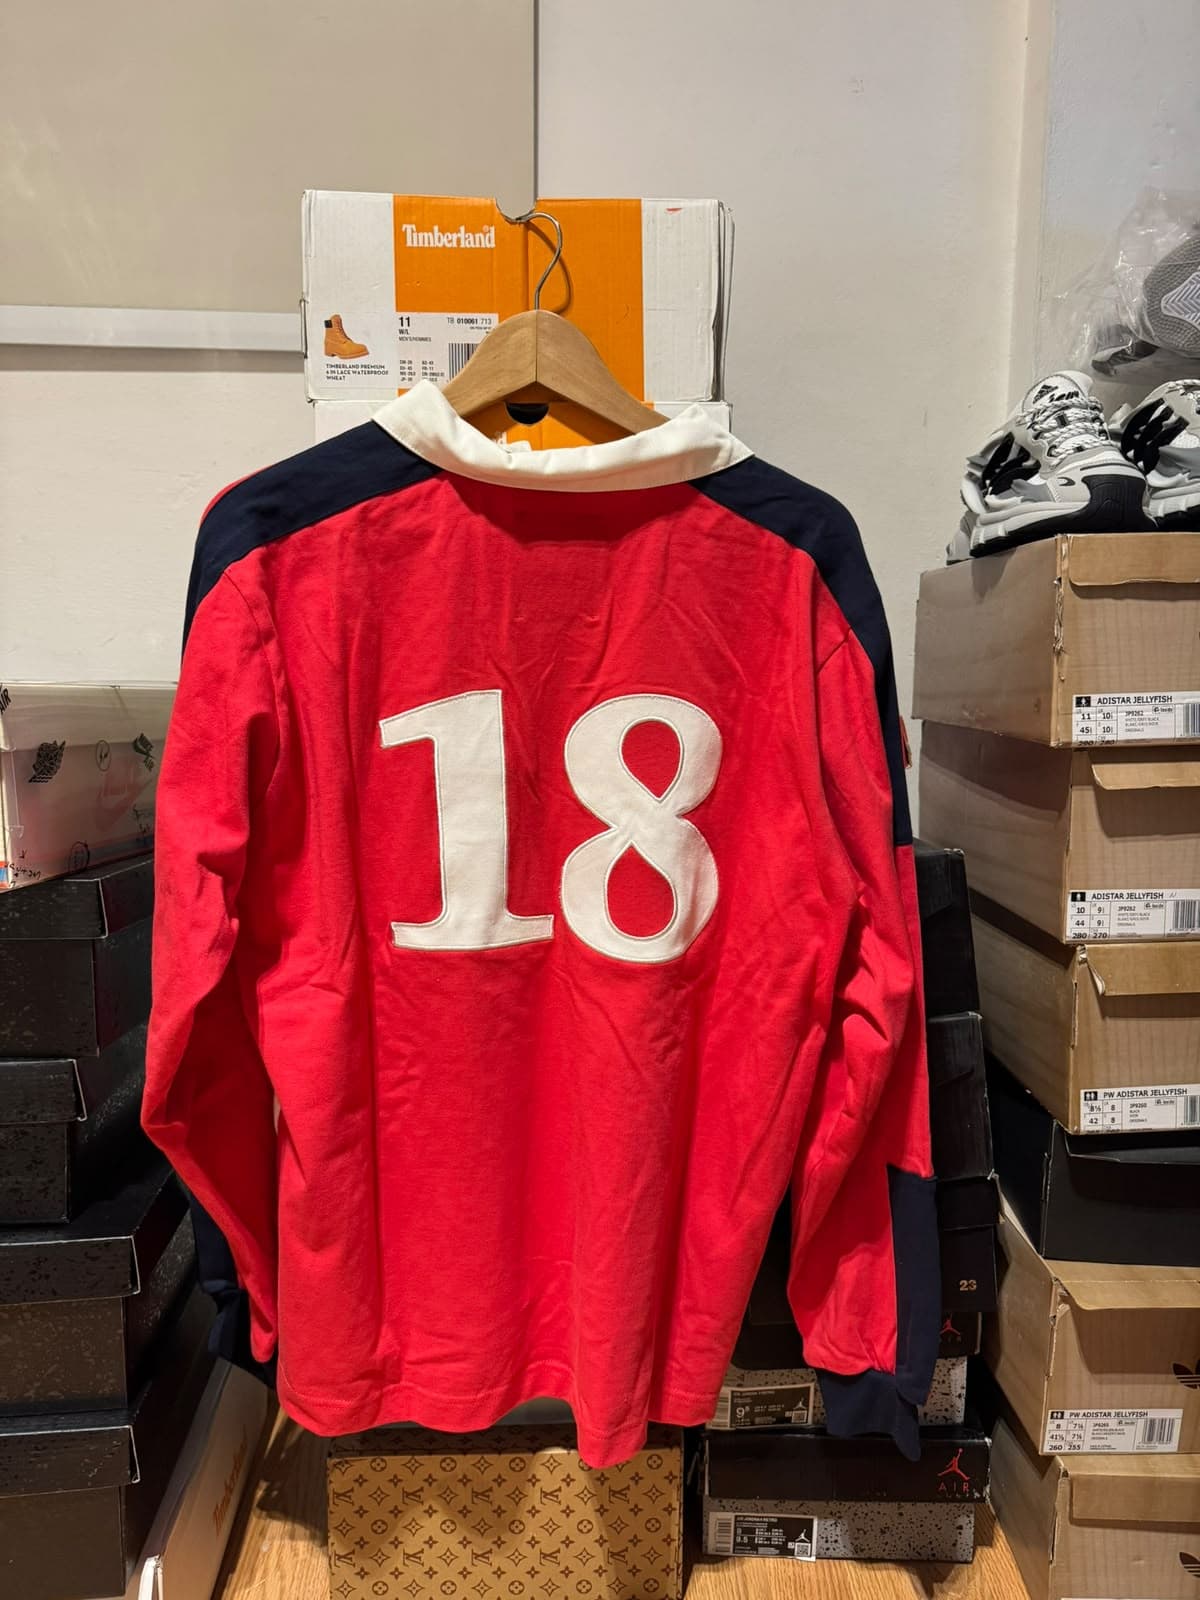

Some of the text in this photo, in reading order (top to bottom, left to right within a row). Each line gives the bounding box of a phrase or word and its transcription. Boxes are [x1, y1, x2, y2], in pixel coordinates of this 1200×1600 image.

[402, 224, 496, 248] Timberland
[399, 316, 410, 328] 11
[1097, 695, 1173, 705] ADISTAR JELLYFISH
[379, 689, 723, 964] 18
[1126, 892, 1164, 900] JELLYFISH
[1103, 1088, 1188, 1099] PW ADISTAR JELLYFISH
[960, 1280, 977, 1291] 23
[938, 1482, 969, 1493] AIR
